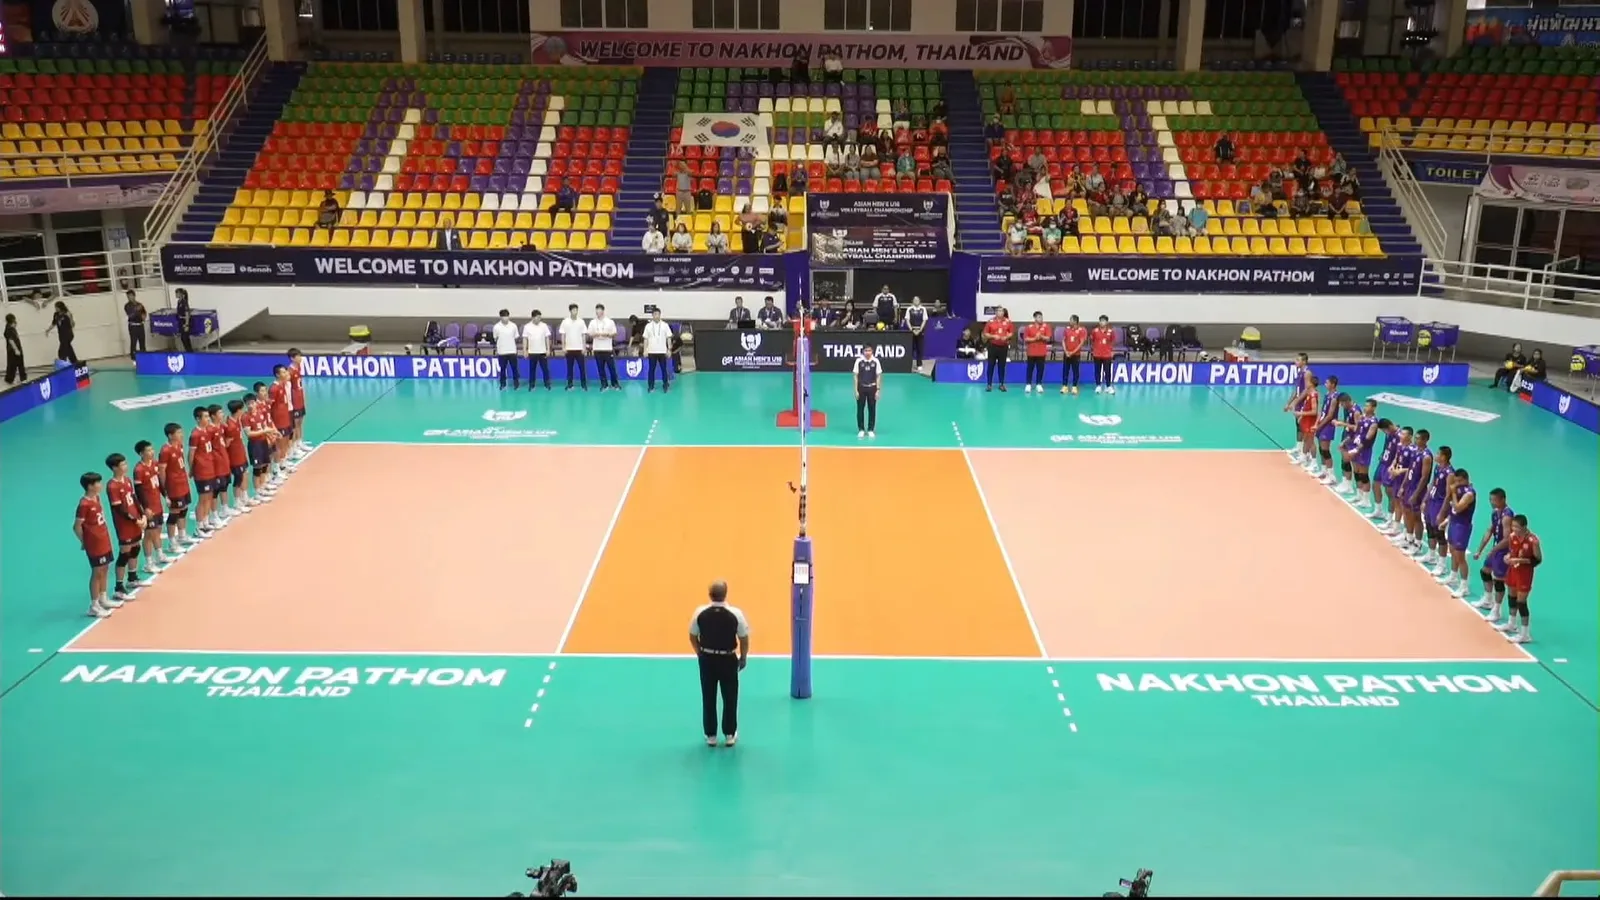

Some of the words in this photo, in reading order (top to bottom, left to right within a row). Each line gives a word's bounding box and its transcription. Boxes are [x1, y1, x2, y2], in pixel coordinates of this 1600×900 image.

[580, 41, 681, 59] WELCOME
[688, 42, 714, 58] TO
[718, 42, 813, 61] NAKHON
[916, 44, 1024, 61] THAILAND
[1426, 167, 1483, 179] TOILET
[314, 257, 417, 274] WELCOME
[421, 259, 449, 275] TO
[453, 260, 545, 277] NAKHON
[549, 261, 635, 279] PATHOM
[1087, 268, 1160, 281] WELCOME
[1163, 269, 1182, 281] TO
[1185, 270, 1250, 281] NAKHON
[1253, 271, 1315, 283] PATHOM
[823, 344, 906, 358] THAIAND
[300, 356, 395, 377] NAKHON
[60, 664, 290, 684] NAKHON
[294, 667, 508, 688] PATHOM
[1095, 672, 1319, 693] NAKHON
[1322, 673, 1539, 693] PATHOM
[205, 685, 351, 697] THAILAND
[1251, 694, 1400, 707] THAILAND
